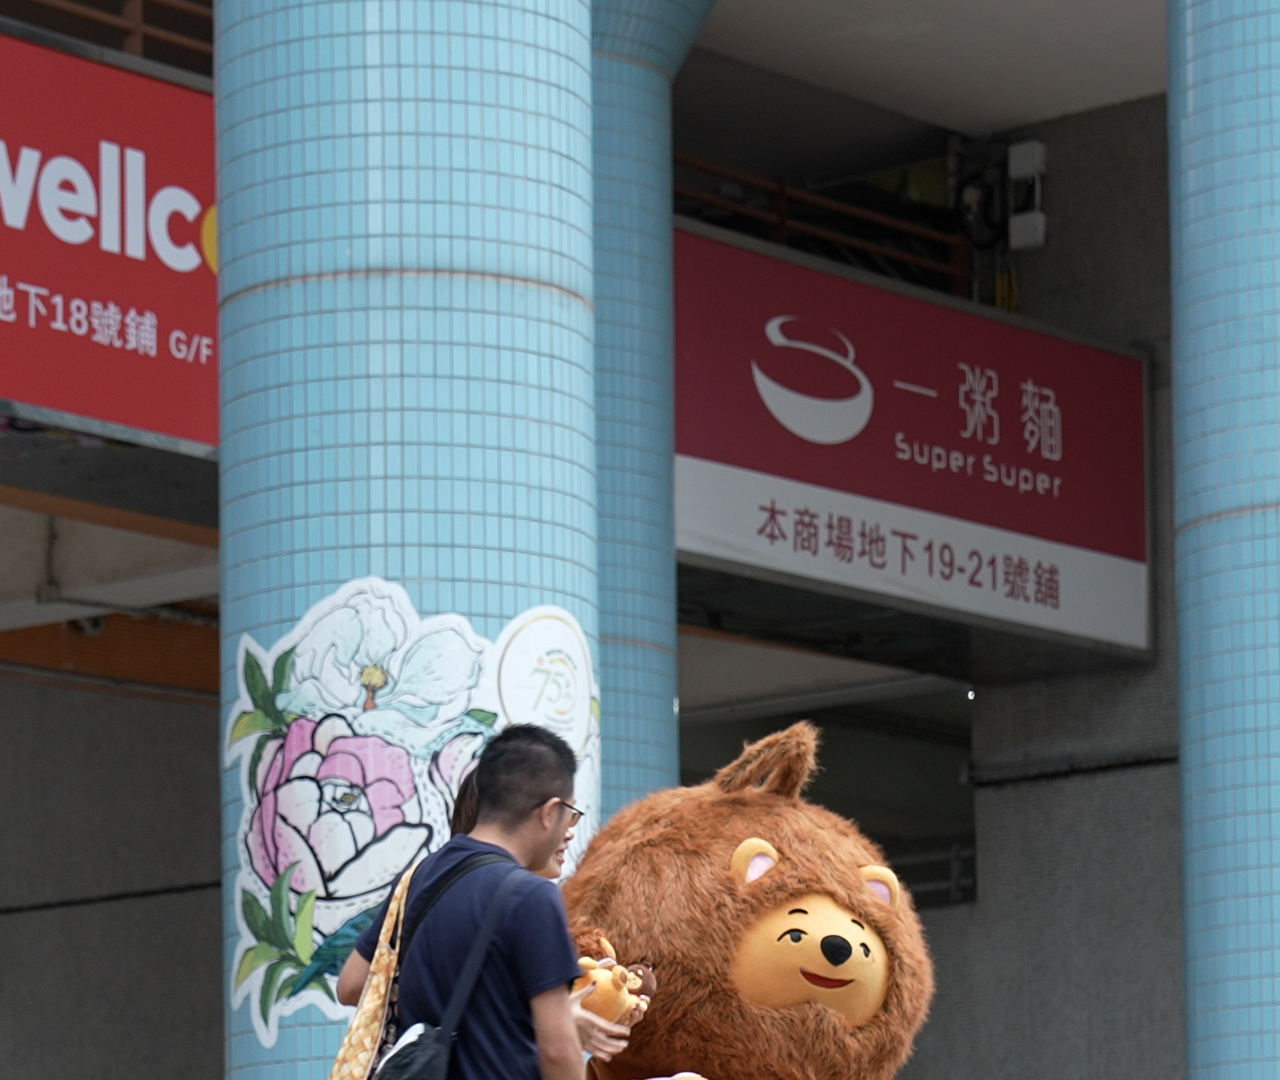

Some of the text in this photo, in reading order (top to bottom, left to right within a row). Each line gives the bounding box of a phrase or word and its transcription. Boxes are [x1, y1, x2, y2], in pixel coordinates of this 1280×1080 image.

[168, 329, 214, 365] G/F
[894, 431, 1063, 498] Super Super
